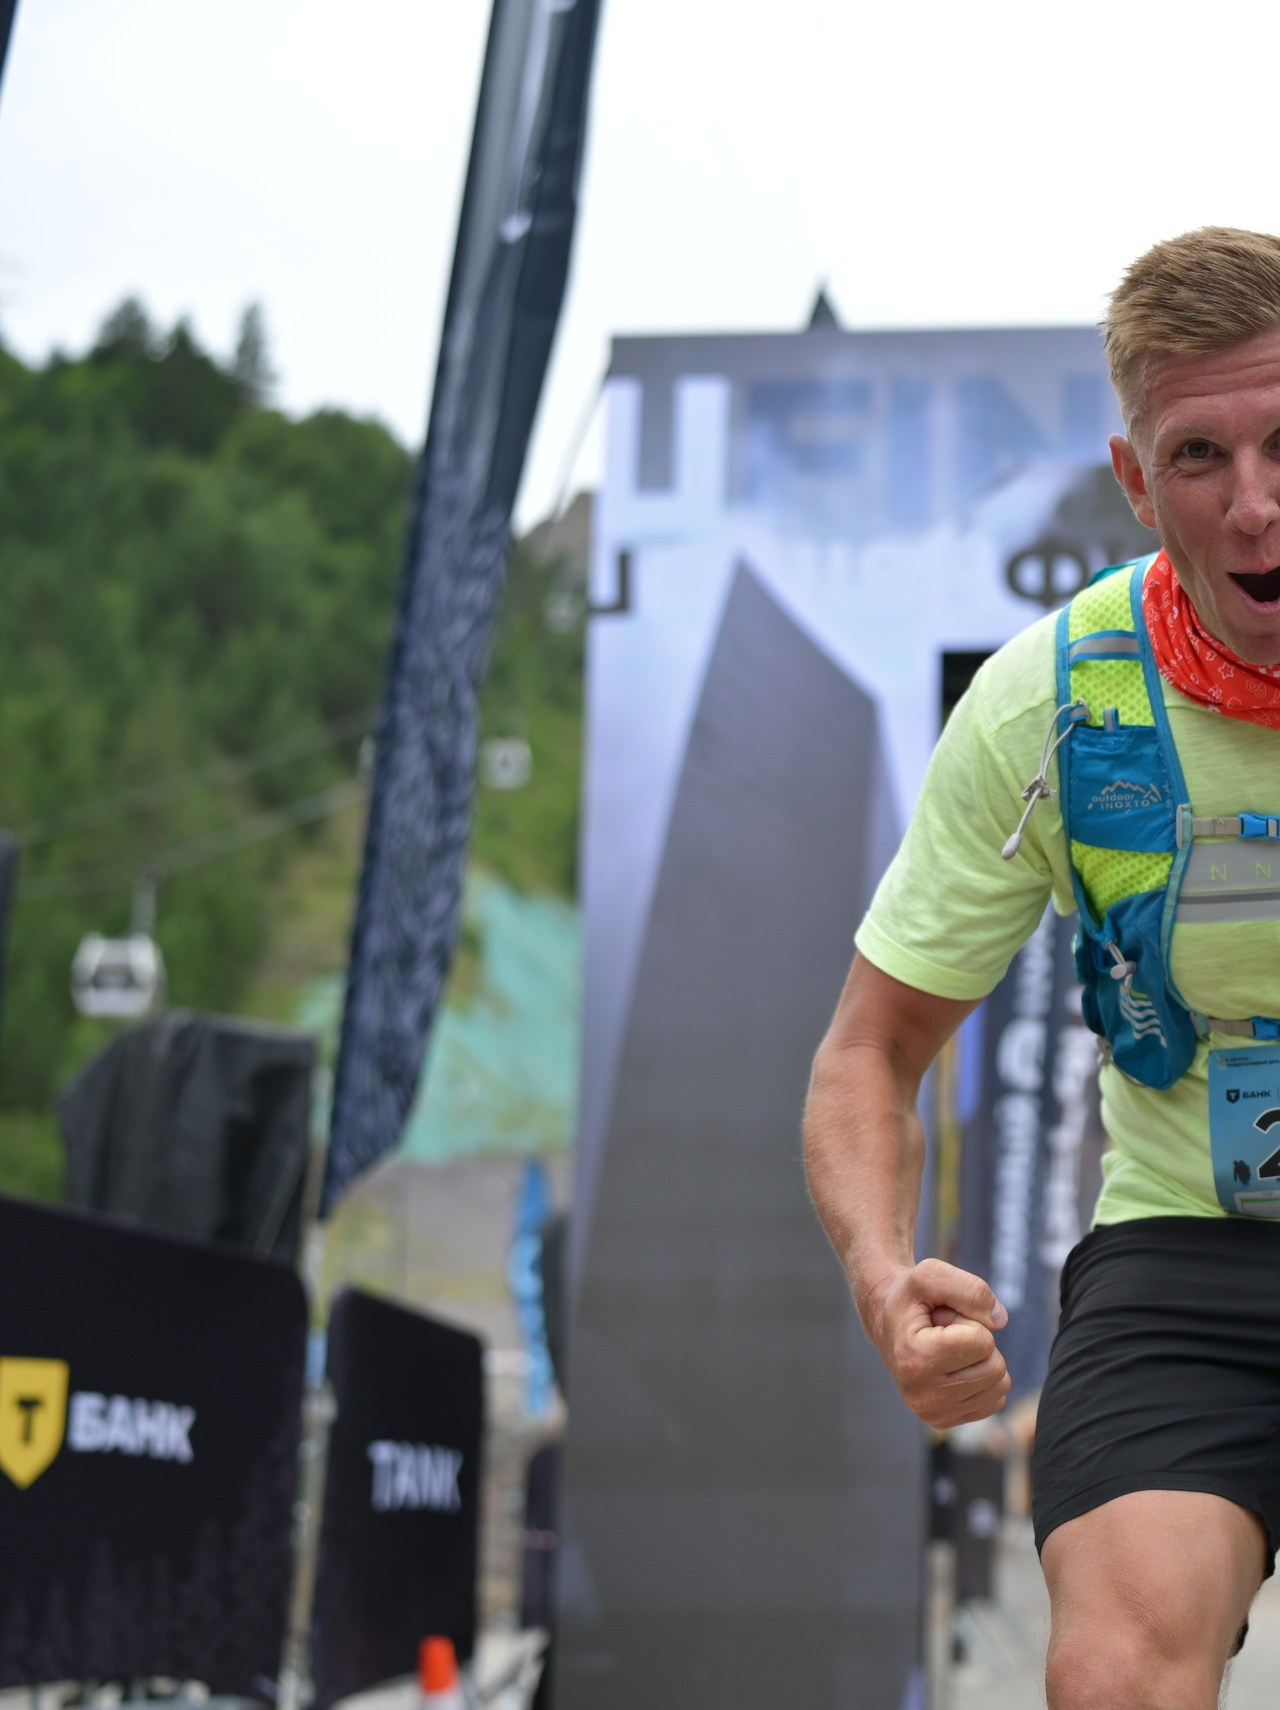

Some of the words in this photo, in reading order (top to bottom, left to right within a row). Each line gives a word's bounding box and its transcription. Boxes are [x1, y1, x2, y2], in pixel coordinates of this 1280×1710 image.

[1092, 793, 1135, 803] outdoor
[1242, 1090, 1271, 1099] БАНК
[68, 1390, 197, 1465] БАНК
